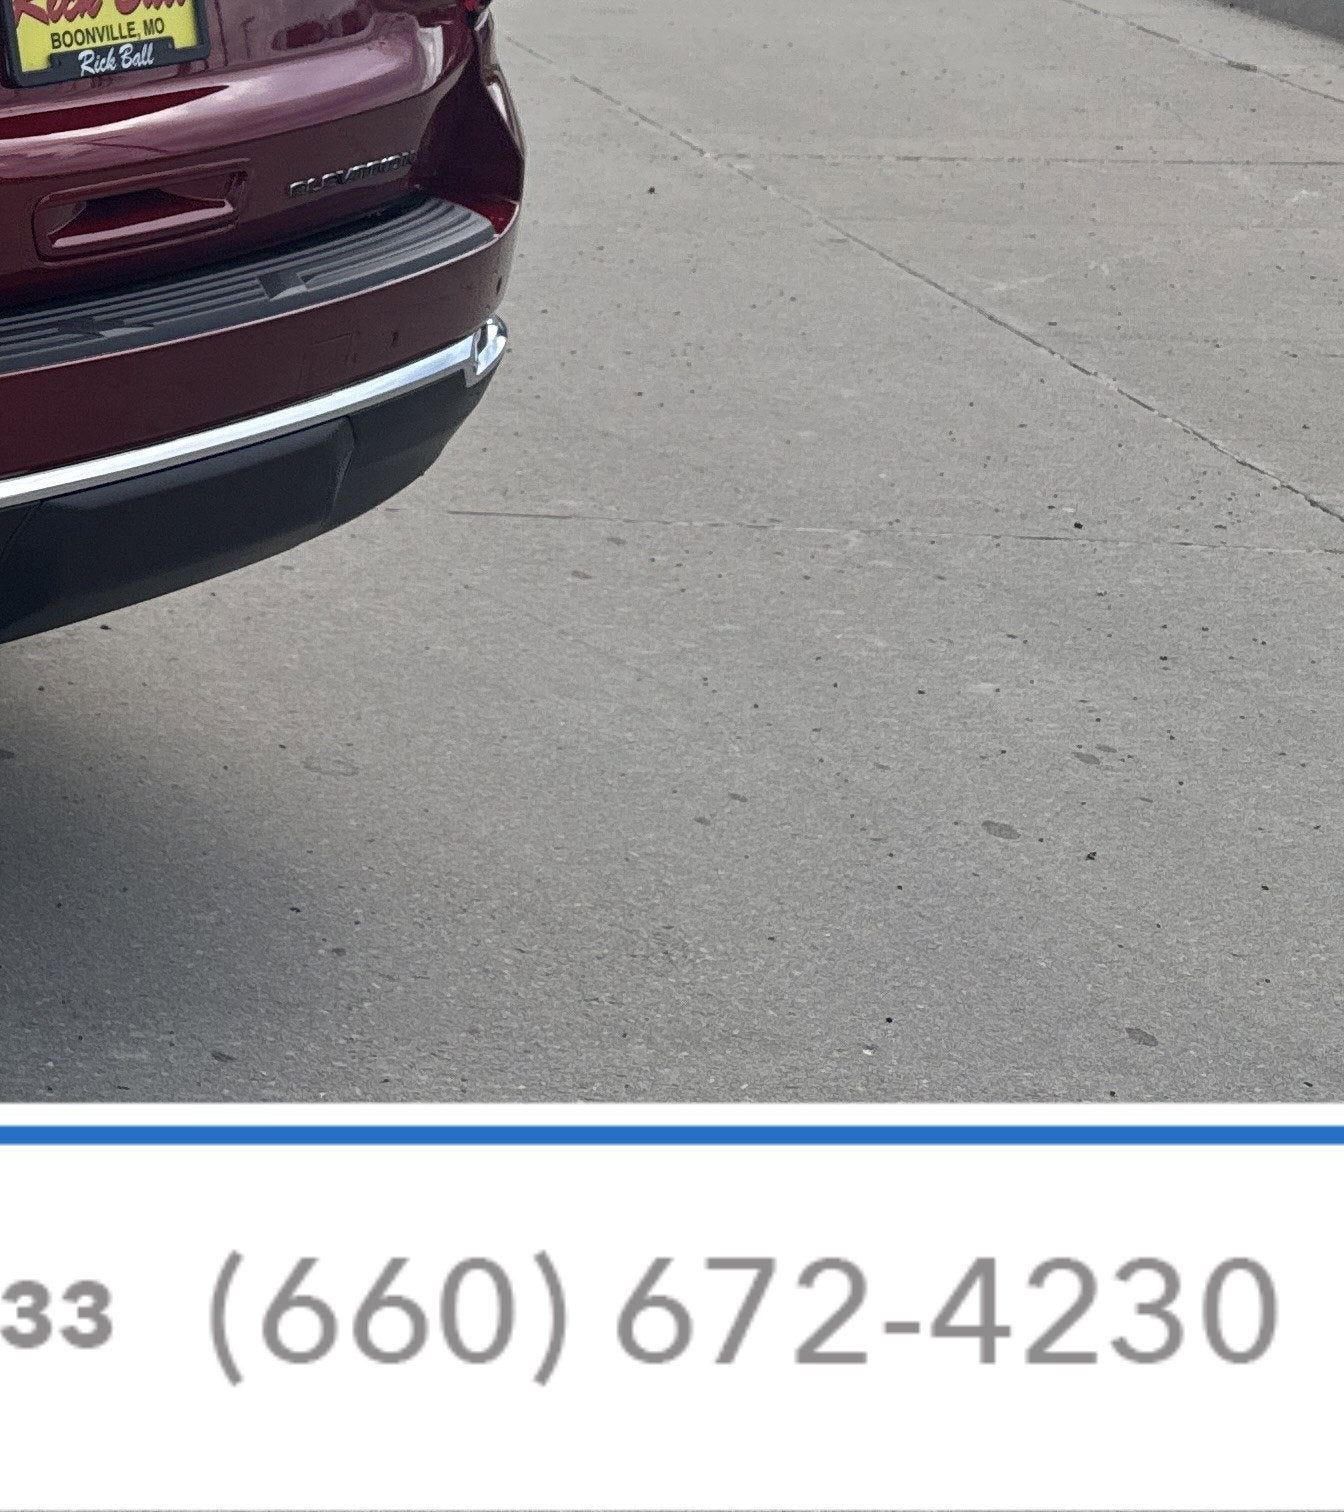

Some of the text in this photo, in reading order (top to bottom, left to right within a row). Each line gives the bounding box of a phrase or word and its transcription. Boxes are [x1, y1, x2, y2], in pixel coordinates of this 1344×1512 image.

[50, 17, 165, 50] BOONVILLE, MO
[77, 42, 154, 77] Rick Ball
